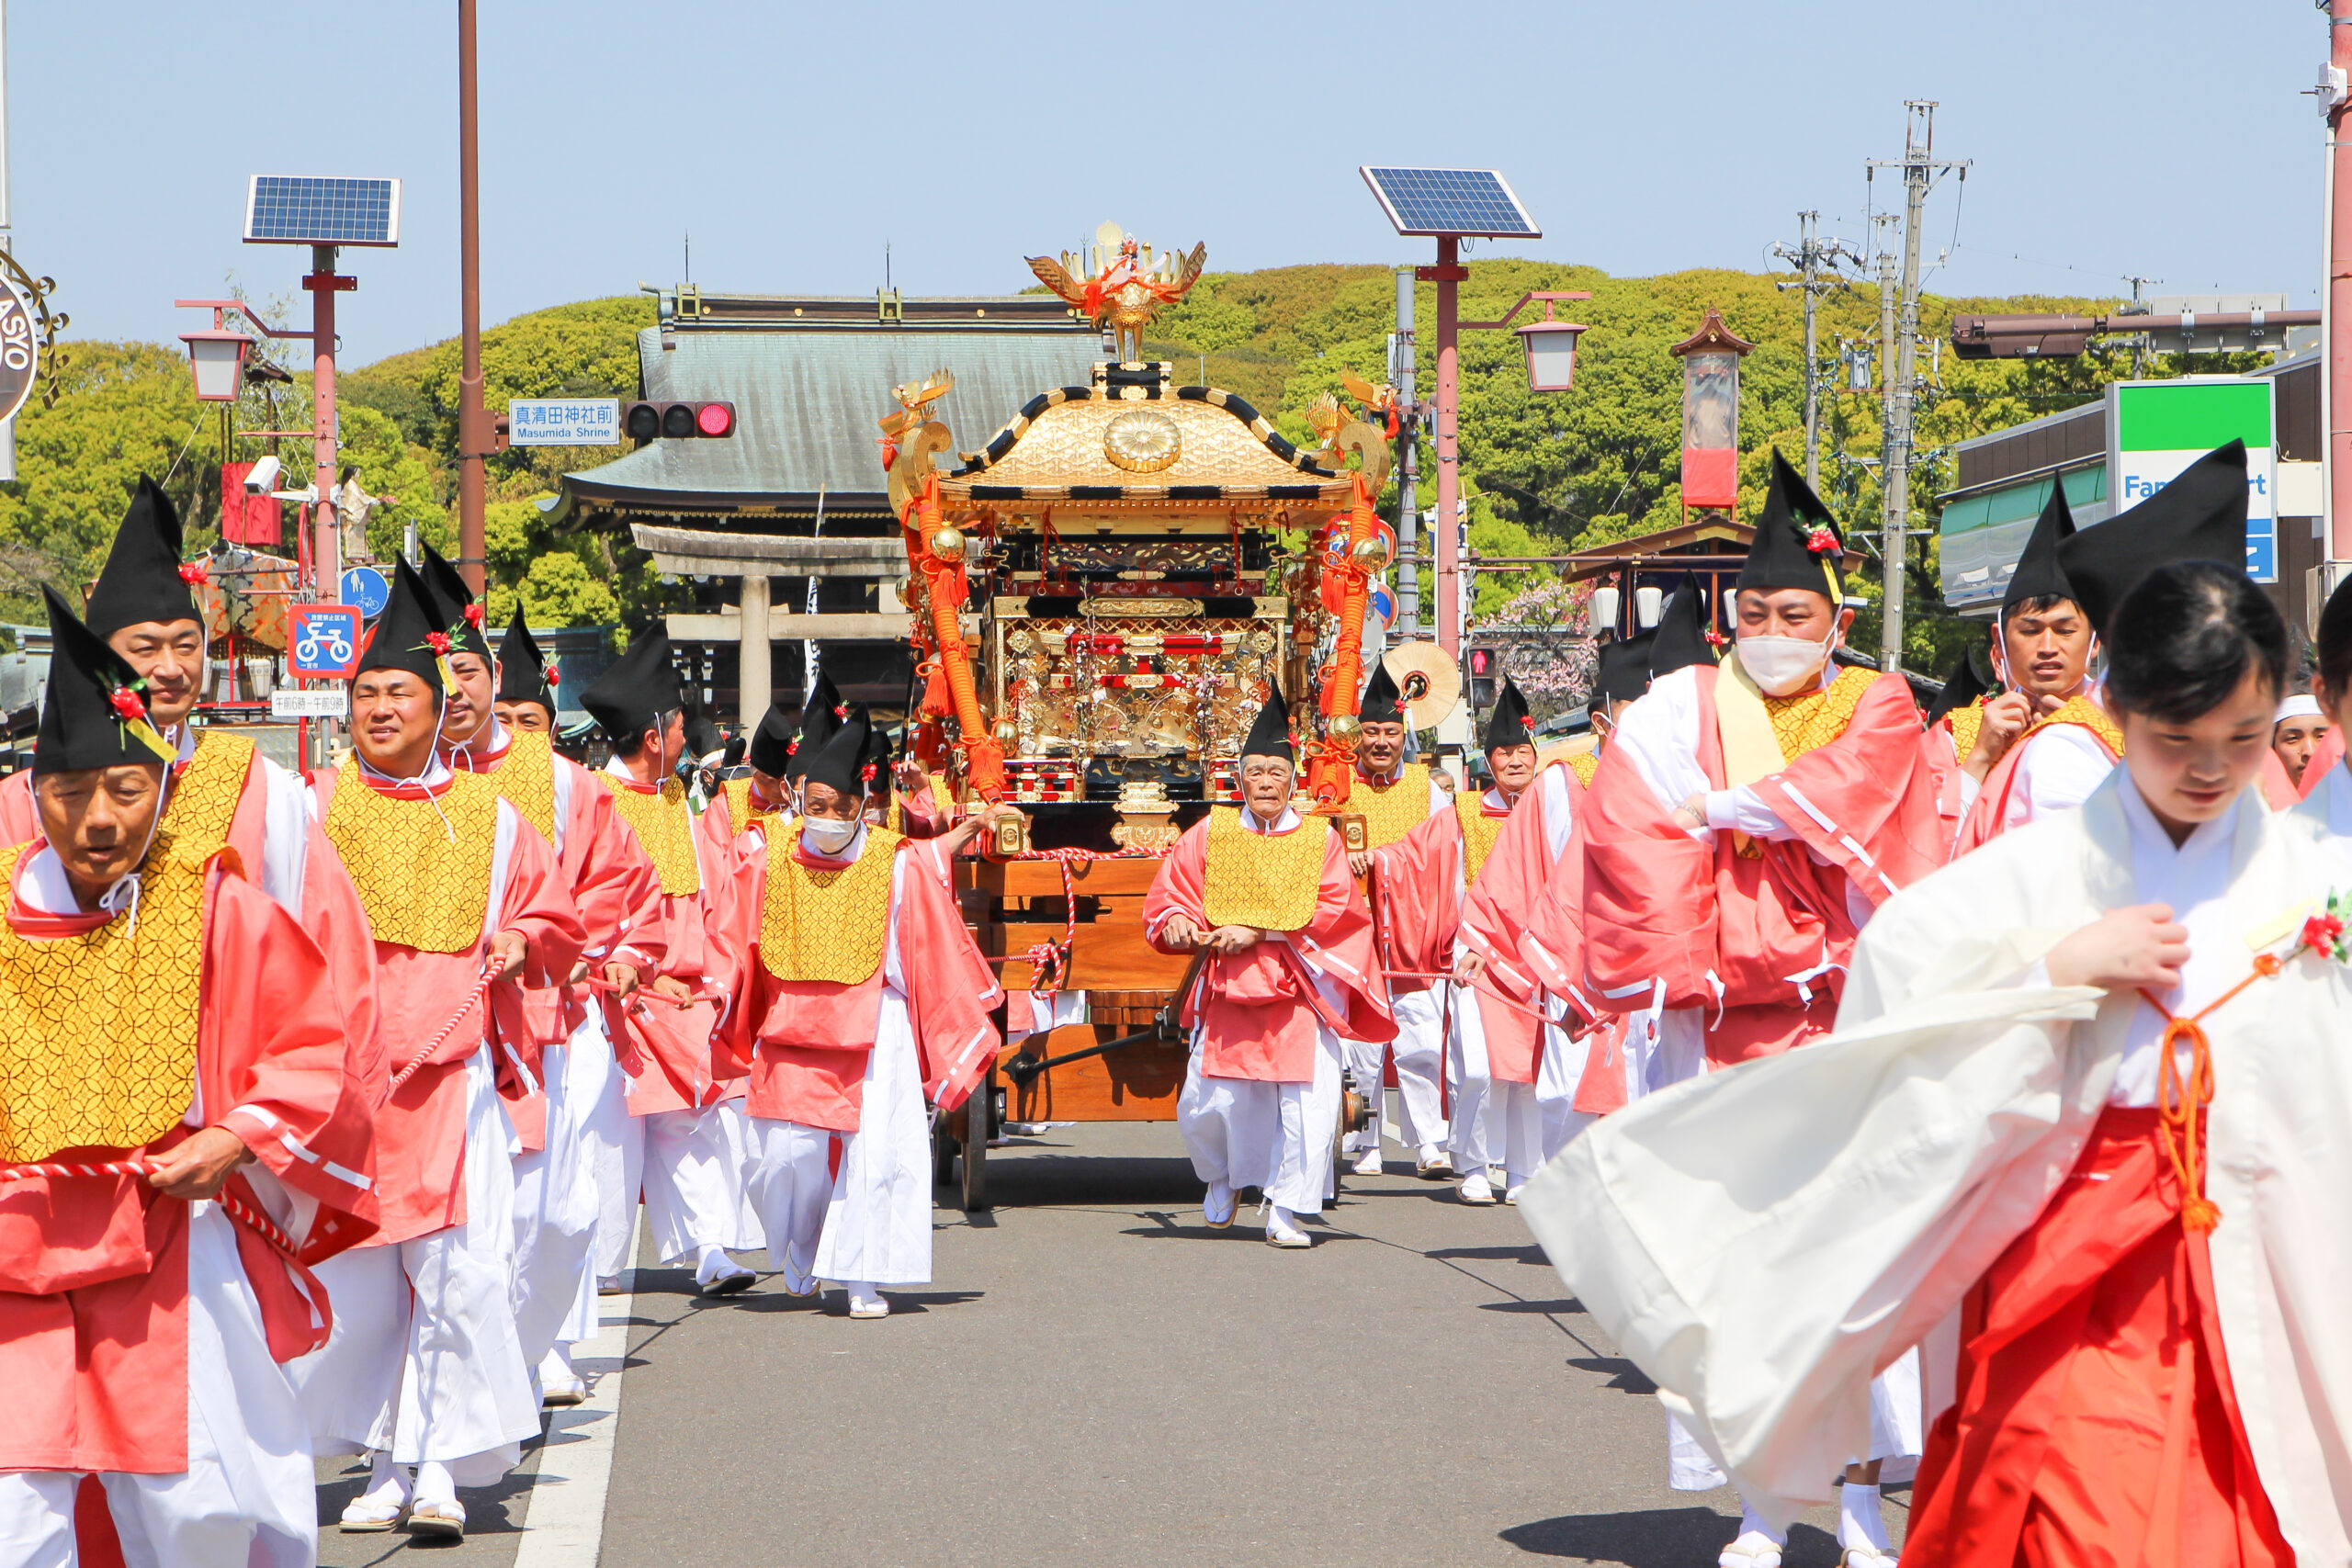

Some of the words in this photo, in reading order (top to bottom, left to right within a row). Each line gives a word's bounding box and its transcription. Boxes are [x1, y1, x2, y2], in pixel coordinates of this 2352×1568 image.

[515, 406, 613, 425] 真清田神社前
[517, 428, 571, 438] Masumida
[576, 427, 610, 438] Shrine
